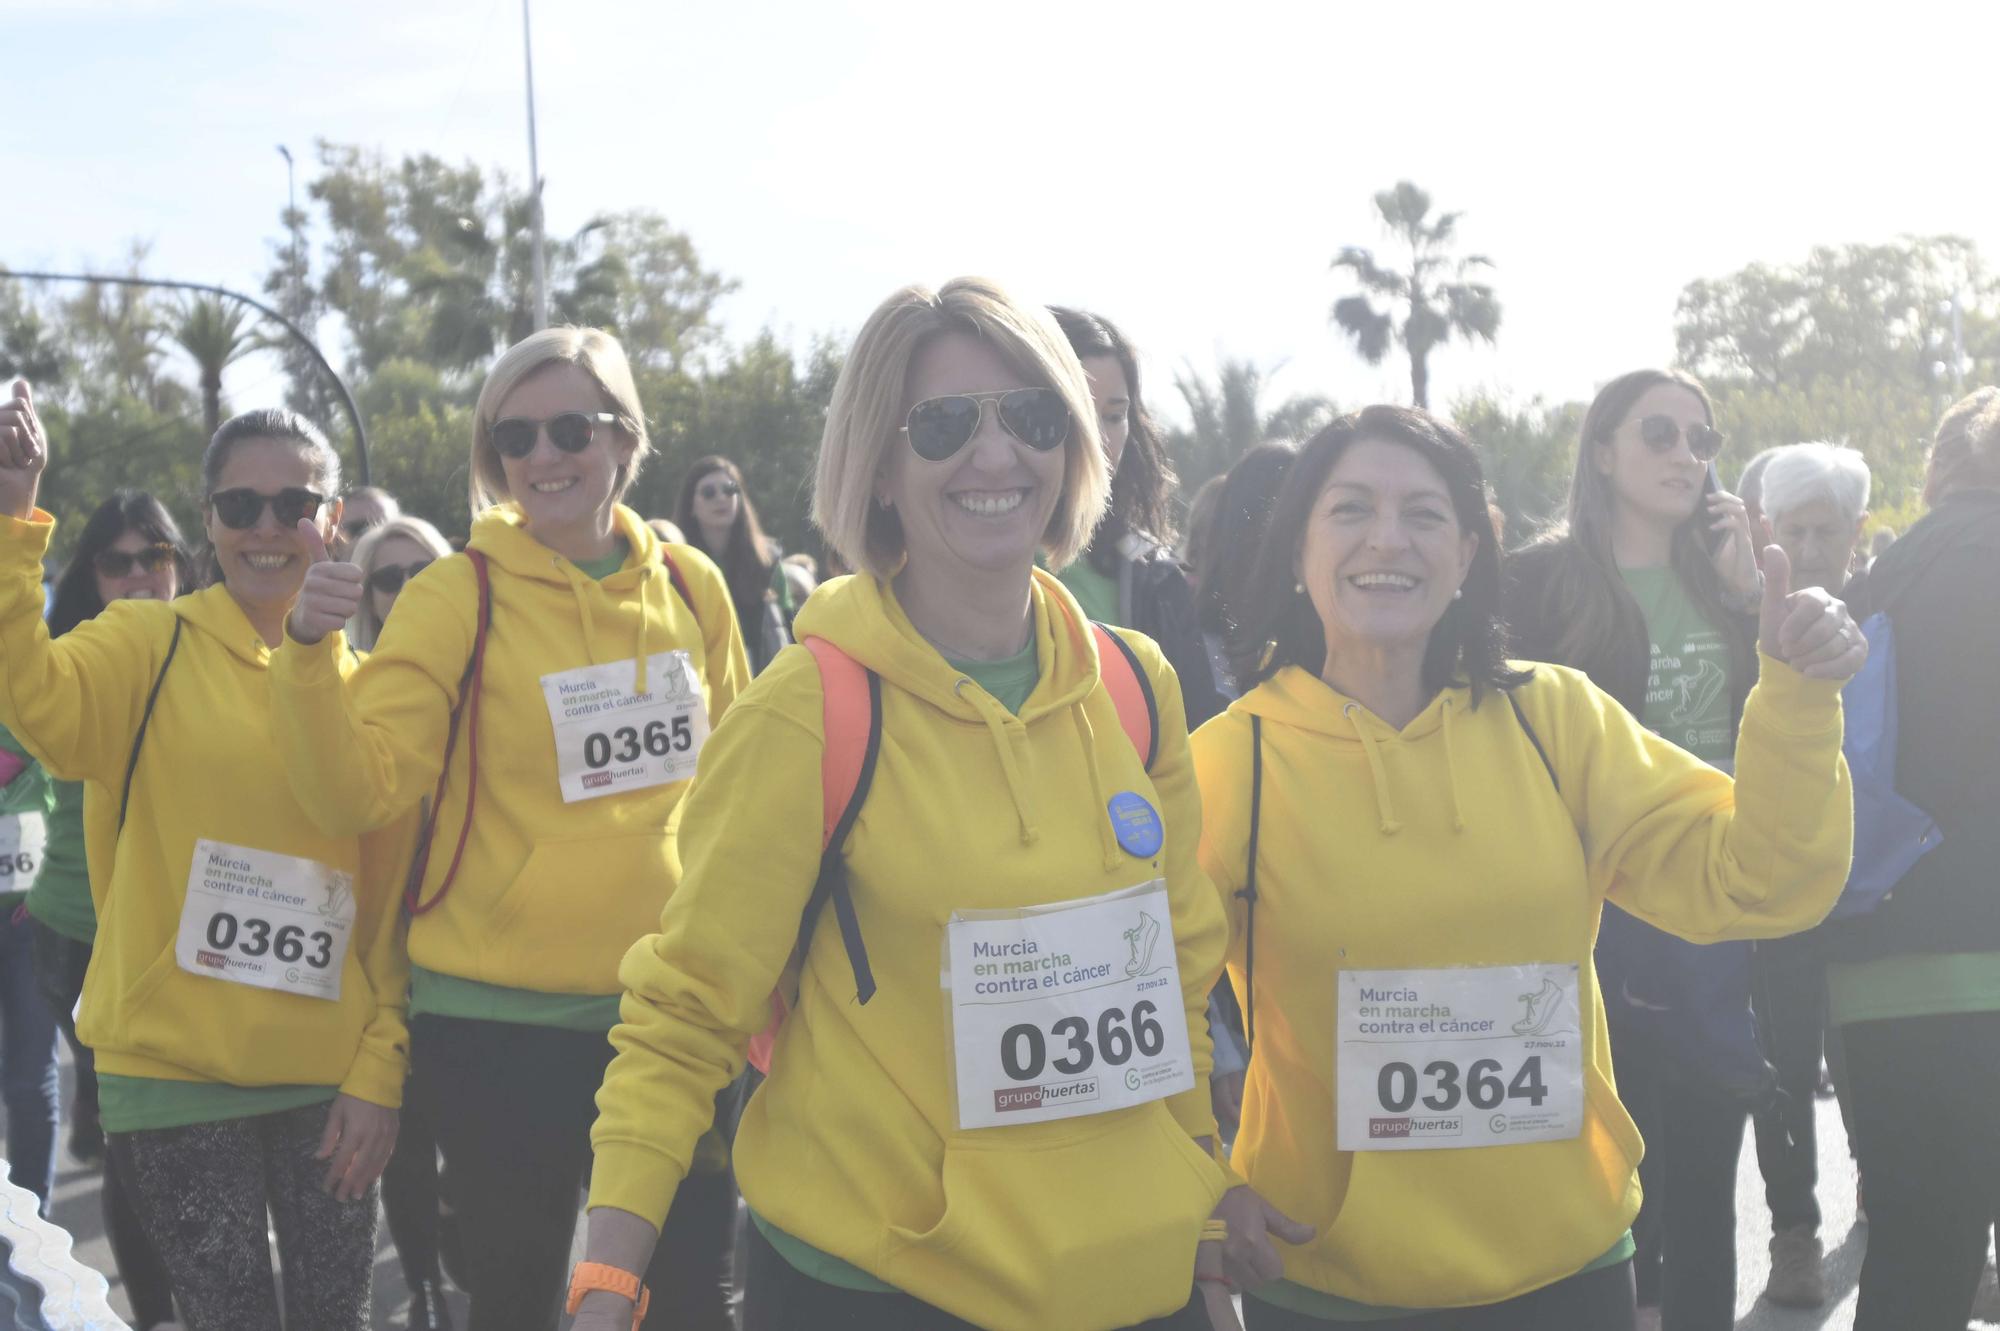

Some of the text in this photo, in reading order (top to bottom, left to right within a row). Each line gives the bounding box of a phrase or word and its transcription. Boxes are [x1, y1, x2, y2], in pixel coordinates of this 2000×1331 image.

[558, 679, 597, 695] Murcia
[562, 687, 621, 706] en marcha
[565, 692, 653, 717] contra el cáncer
[584, 715, 692, 769] 0365
[208, 854, 251, 872] Murcia
[205, 867, 273, 888] en marcha
[204, 879, 306, 906] contra el cáncer
[206, 912, 333, 969] 0363
[973, 938, 1038, 958] Murcia
[974, 952, 1072, 976] en marcha
[975, 962, 1112, 994] contra el cáncer
[1136, 978, 1168, 992] 27.nov.22
[1359, 988, 1418, 1002] Murcia
[1359, 1003, 1450, 1018] en marcha
[1359, 1018, 1495, 1033] contra el cáncer
[1001, 1000, 1164, 1081] 0366
[1377, 1055, 1548, 1113] 0364
